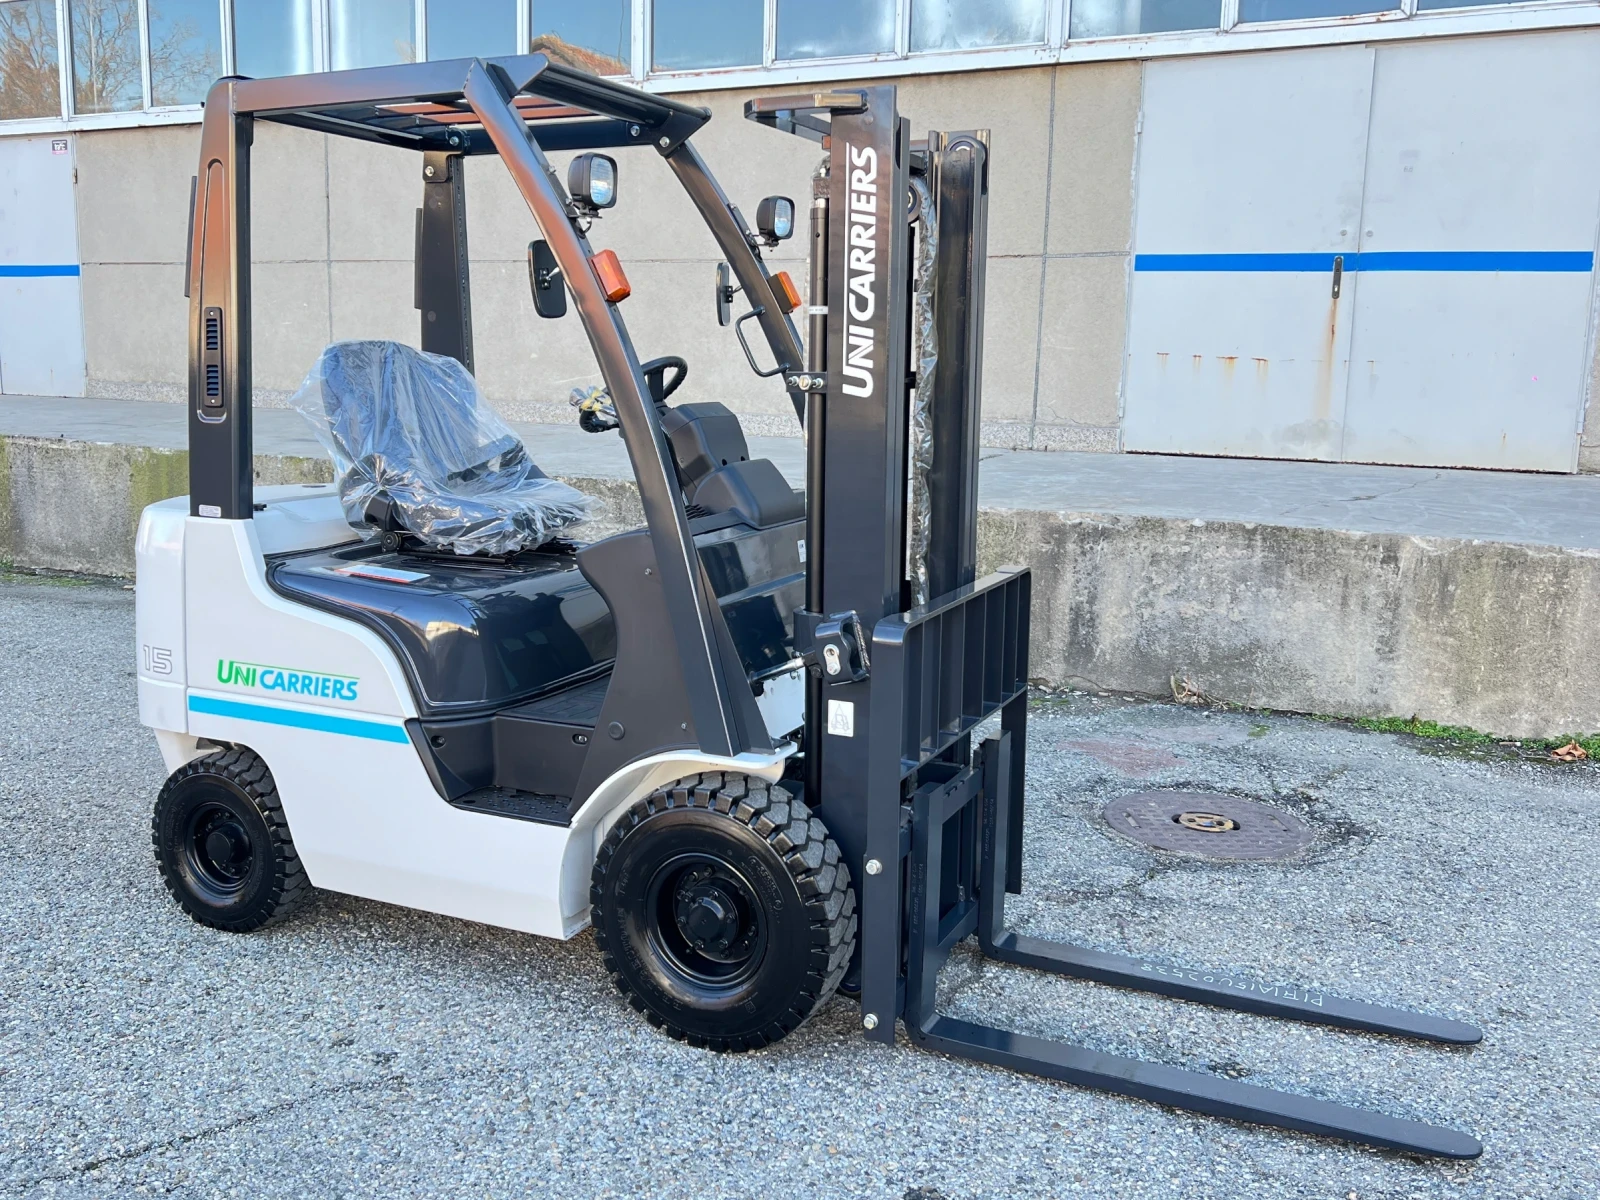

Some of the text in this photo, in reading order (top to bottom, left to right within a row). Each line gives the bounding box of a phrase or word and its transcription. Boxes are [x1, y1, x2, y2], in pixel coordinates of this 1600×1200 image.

[842, 143, 878, 398] UNICARRIERS
[143, 644, 173, 675] 15
[217, 659, 359, 700] UNICARRIERS
